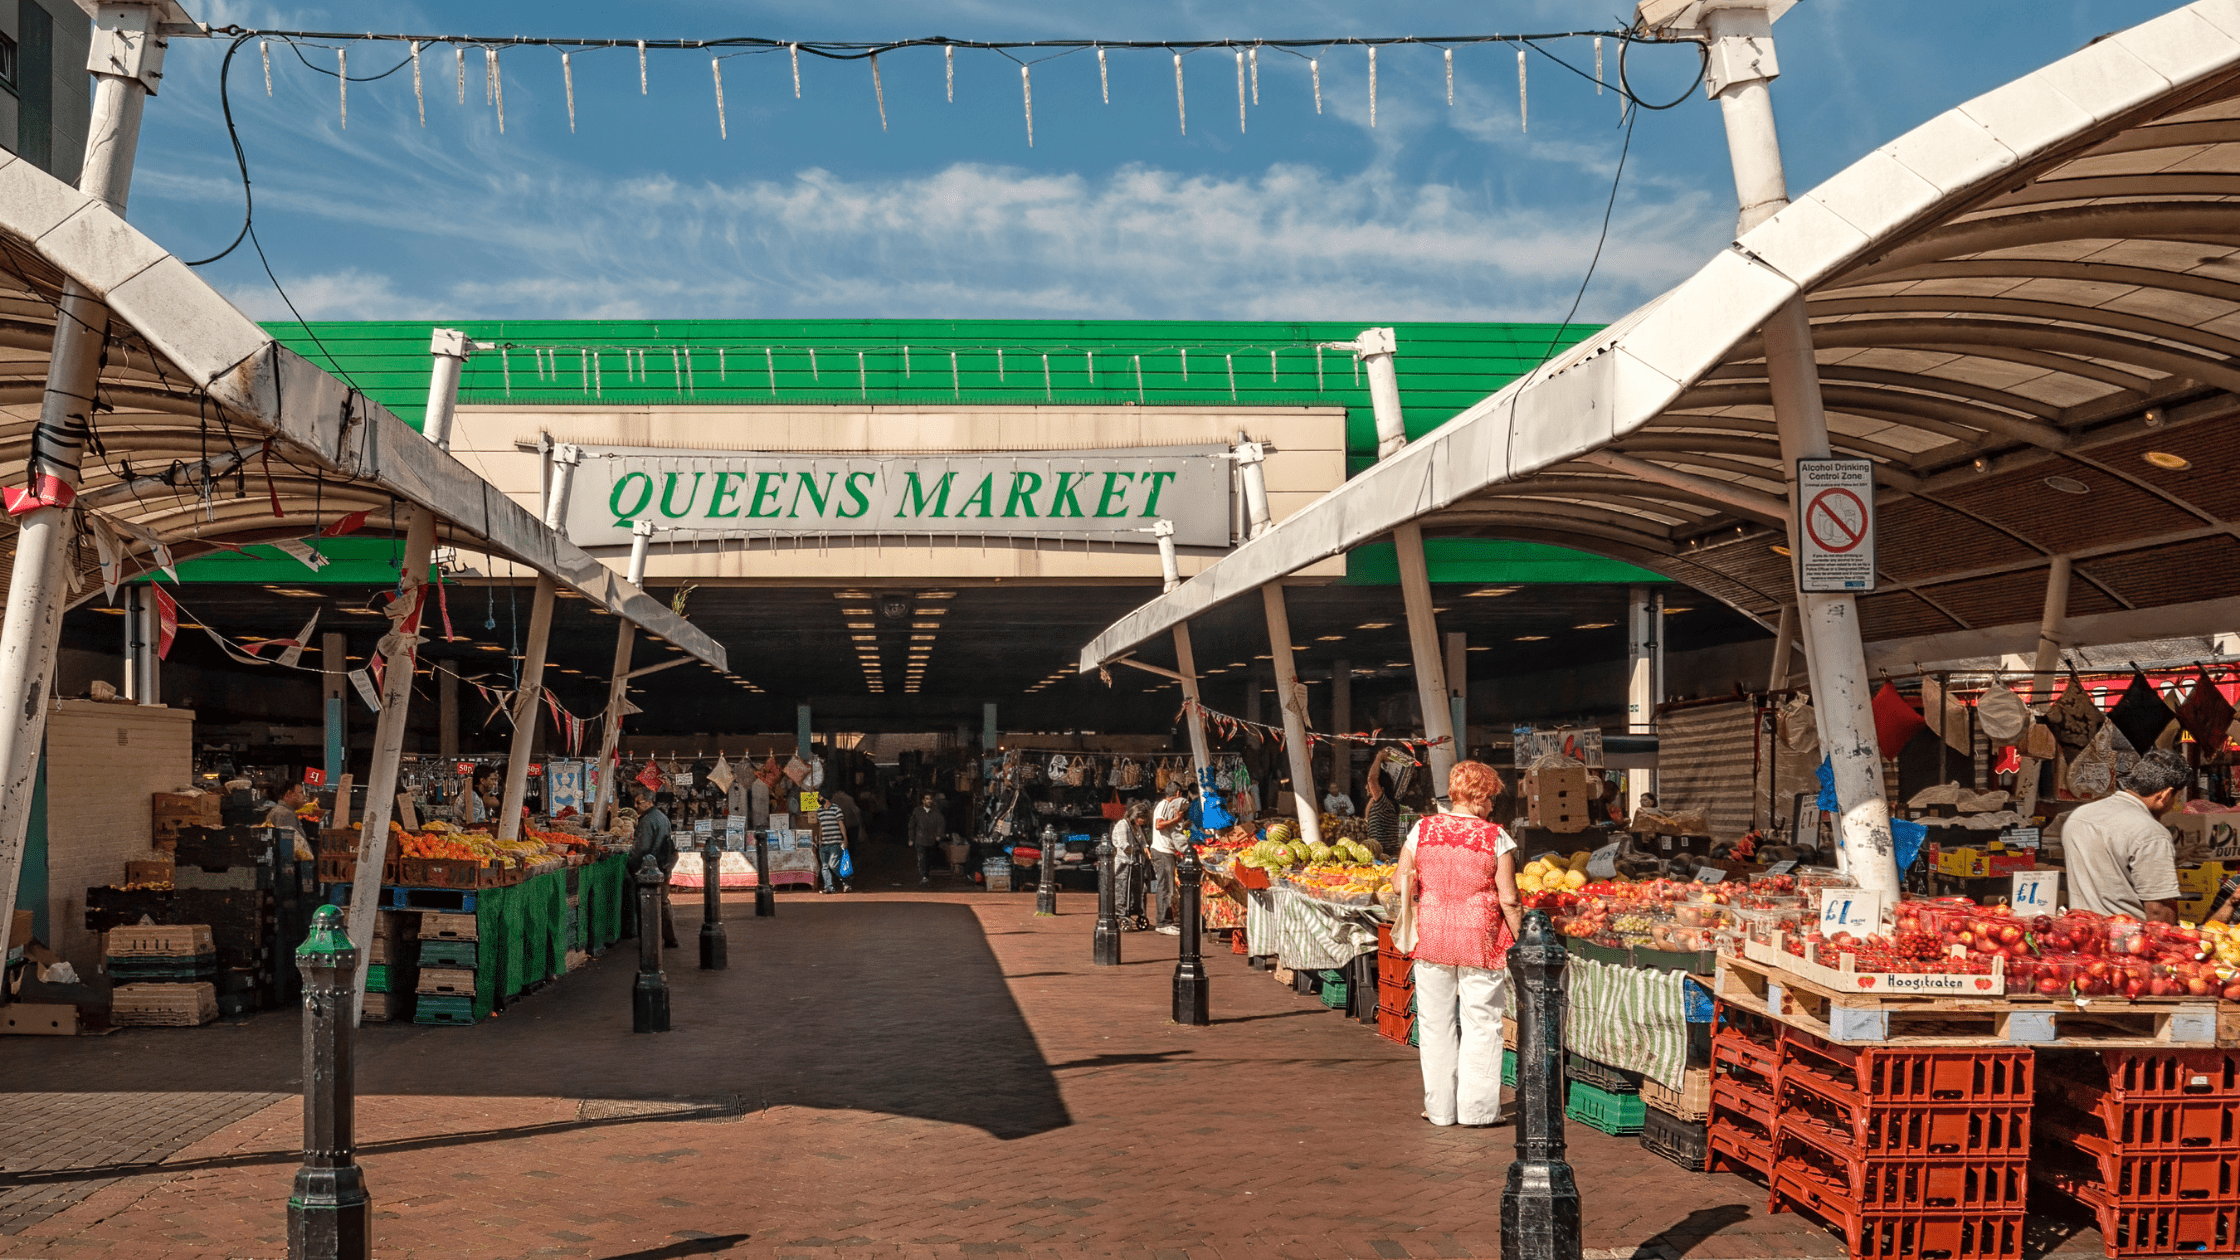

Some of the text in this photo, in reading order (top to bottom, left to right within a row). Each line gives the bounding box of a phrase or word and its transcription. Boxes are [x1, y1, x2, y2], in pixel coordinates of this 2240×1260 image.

[1802, 462, 1870, 473] Alcohol Drinking
[1809, 472, 1863, 480] Control Zone
[609, 471, 1177, 528] QUEENS MARKET
[310, 771, 320, 783] £1
[2216, 846, 2240, 857] DUT
[2015, 882, 2039, 904] £1
[1825, 900, 1852, 925] £1
